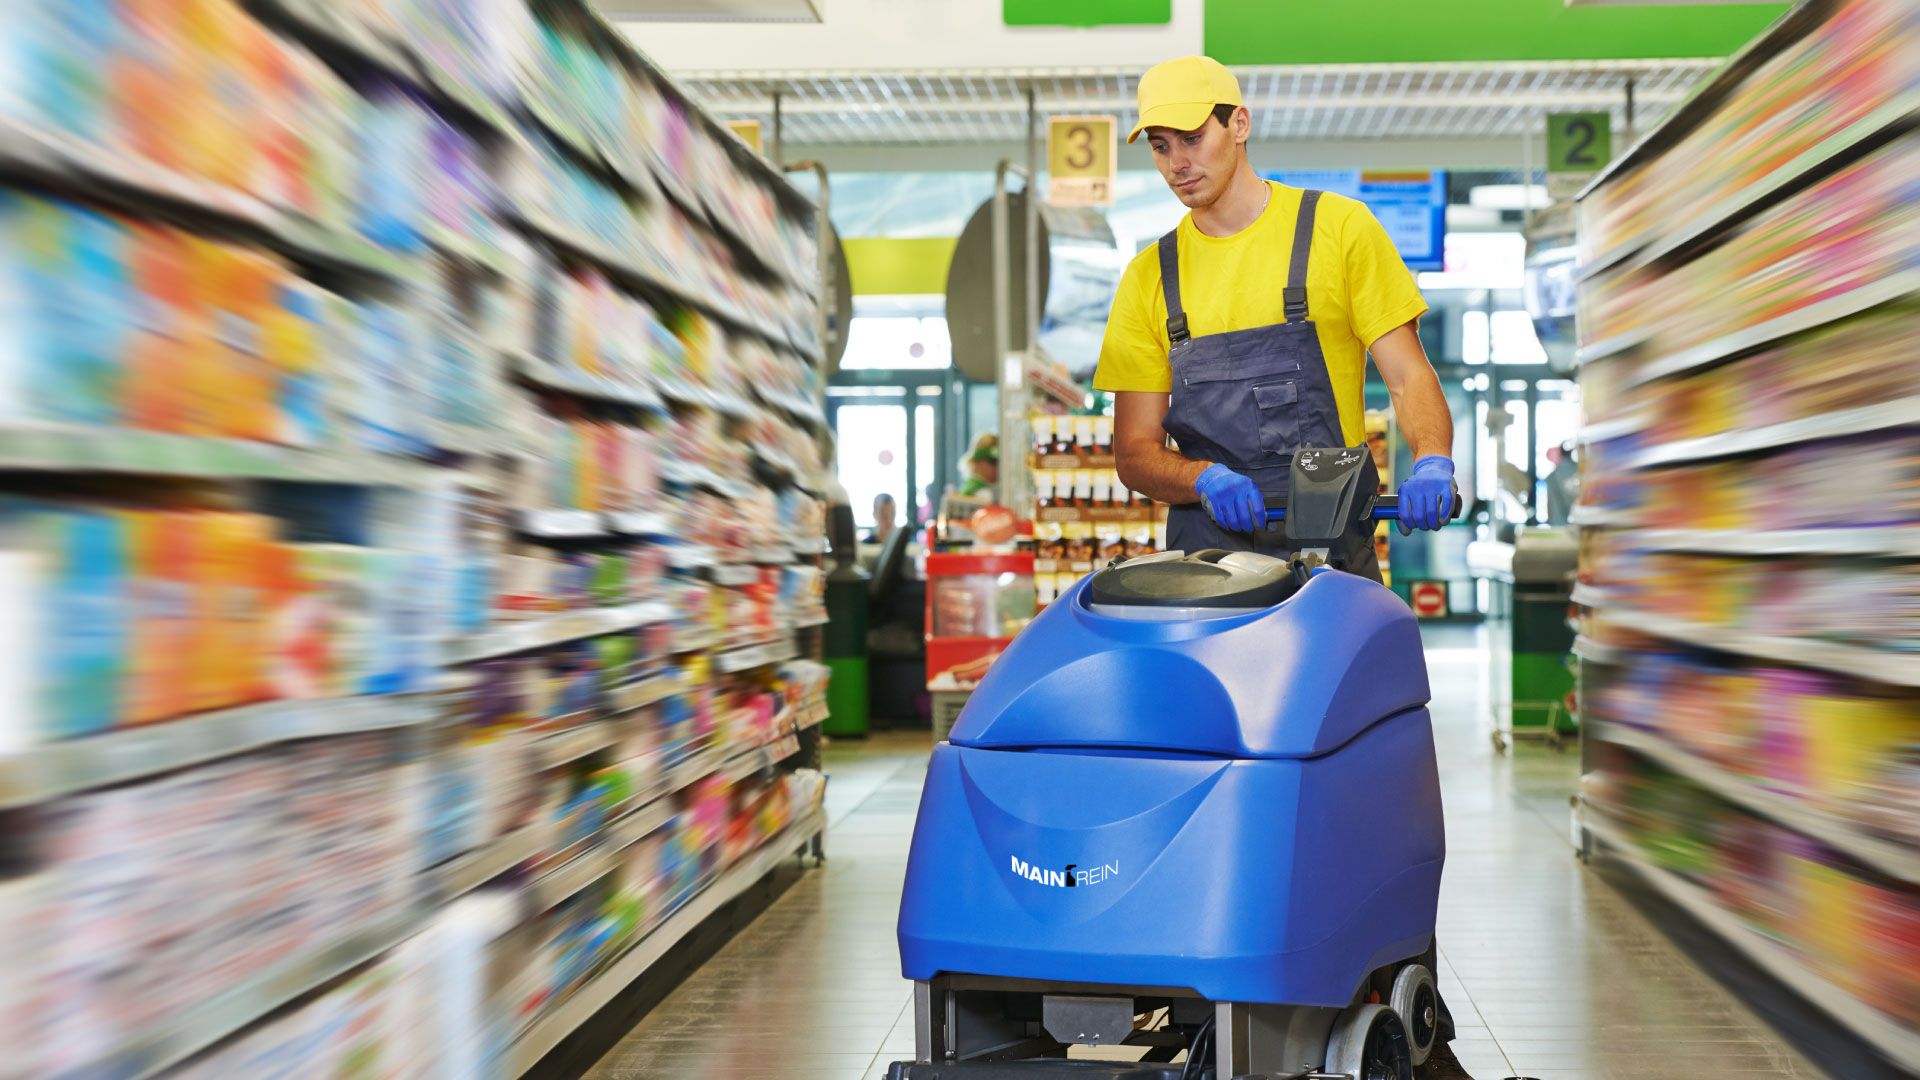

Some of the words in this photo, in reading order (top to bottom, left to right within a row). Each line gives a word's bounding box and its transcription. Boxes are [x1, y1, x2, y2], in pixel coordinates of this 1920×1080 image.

[1065, 125, 1095, 170] 3
[1565, 119, 1596, 165] 2
[1011, 855, 1065, 888] MAIN
[1076, 859, 1119, 887] REIN
